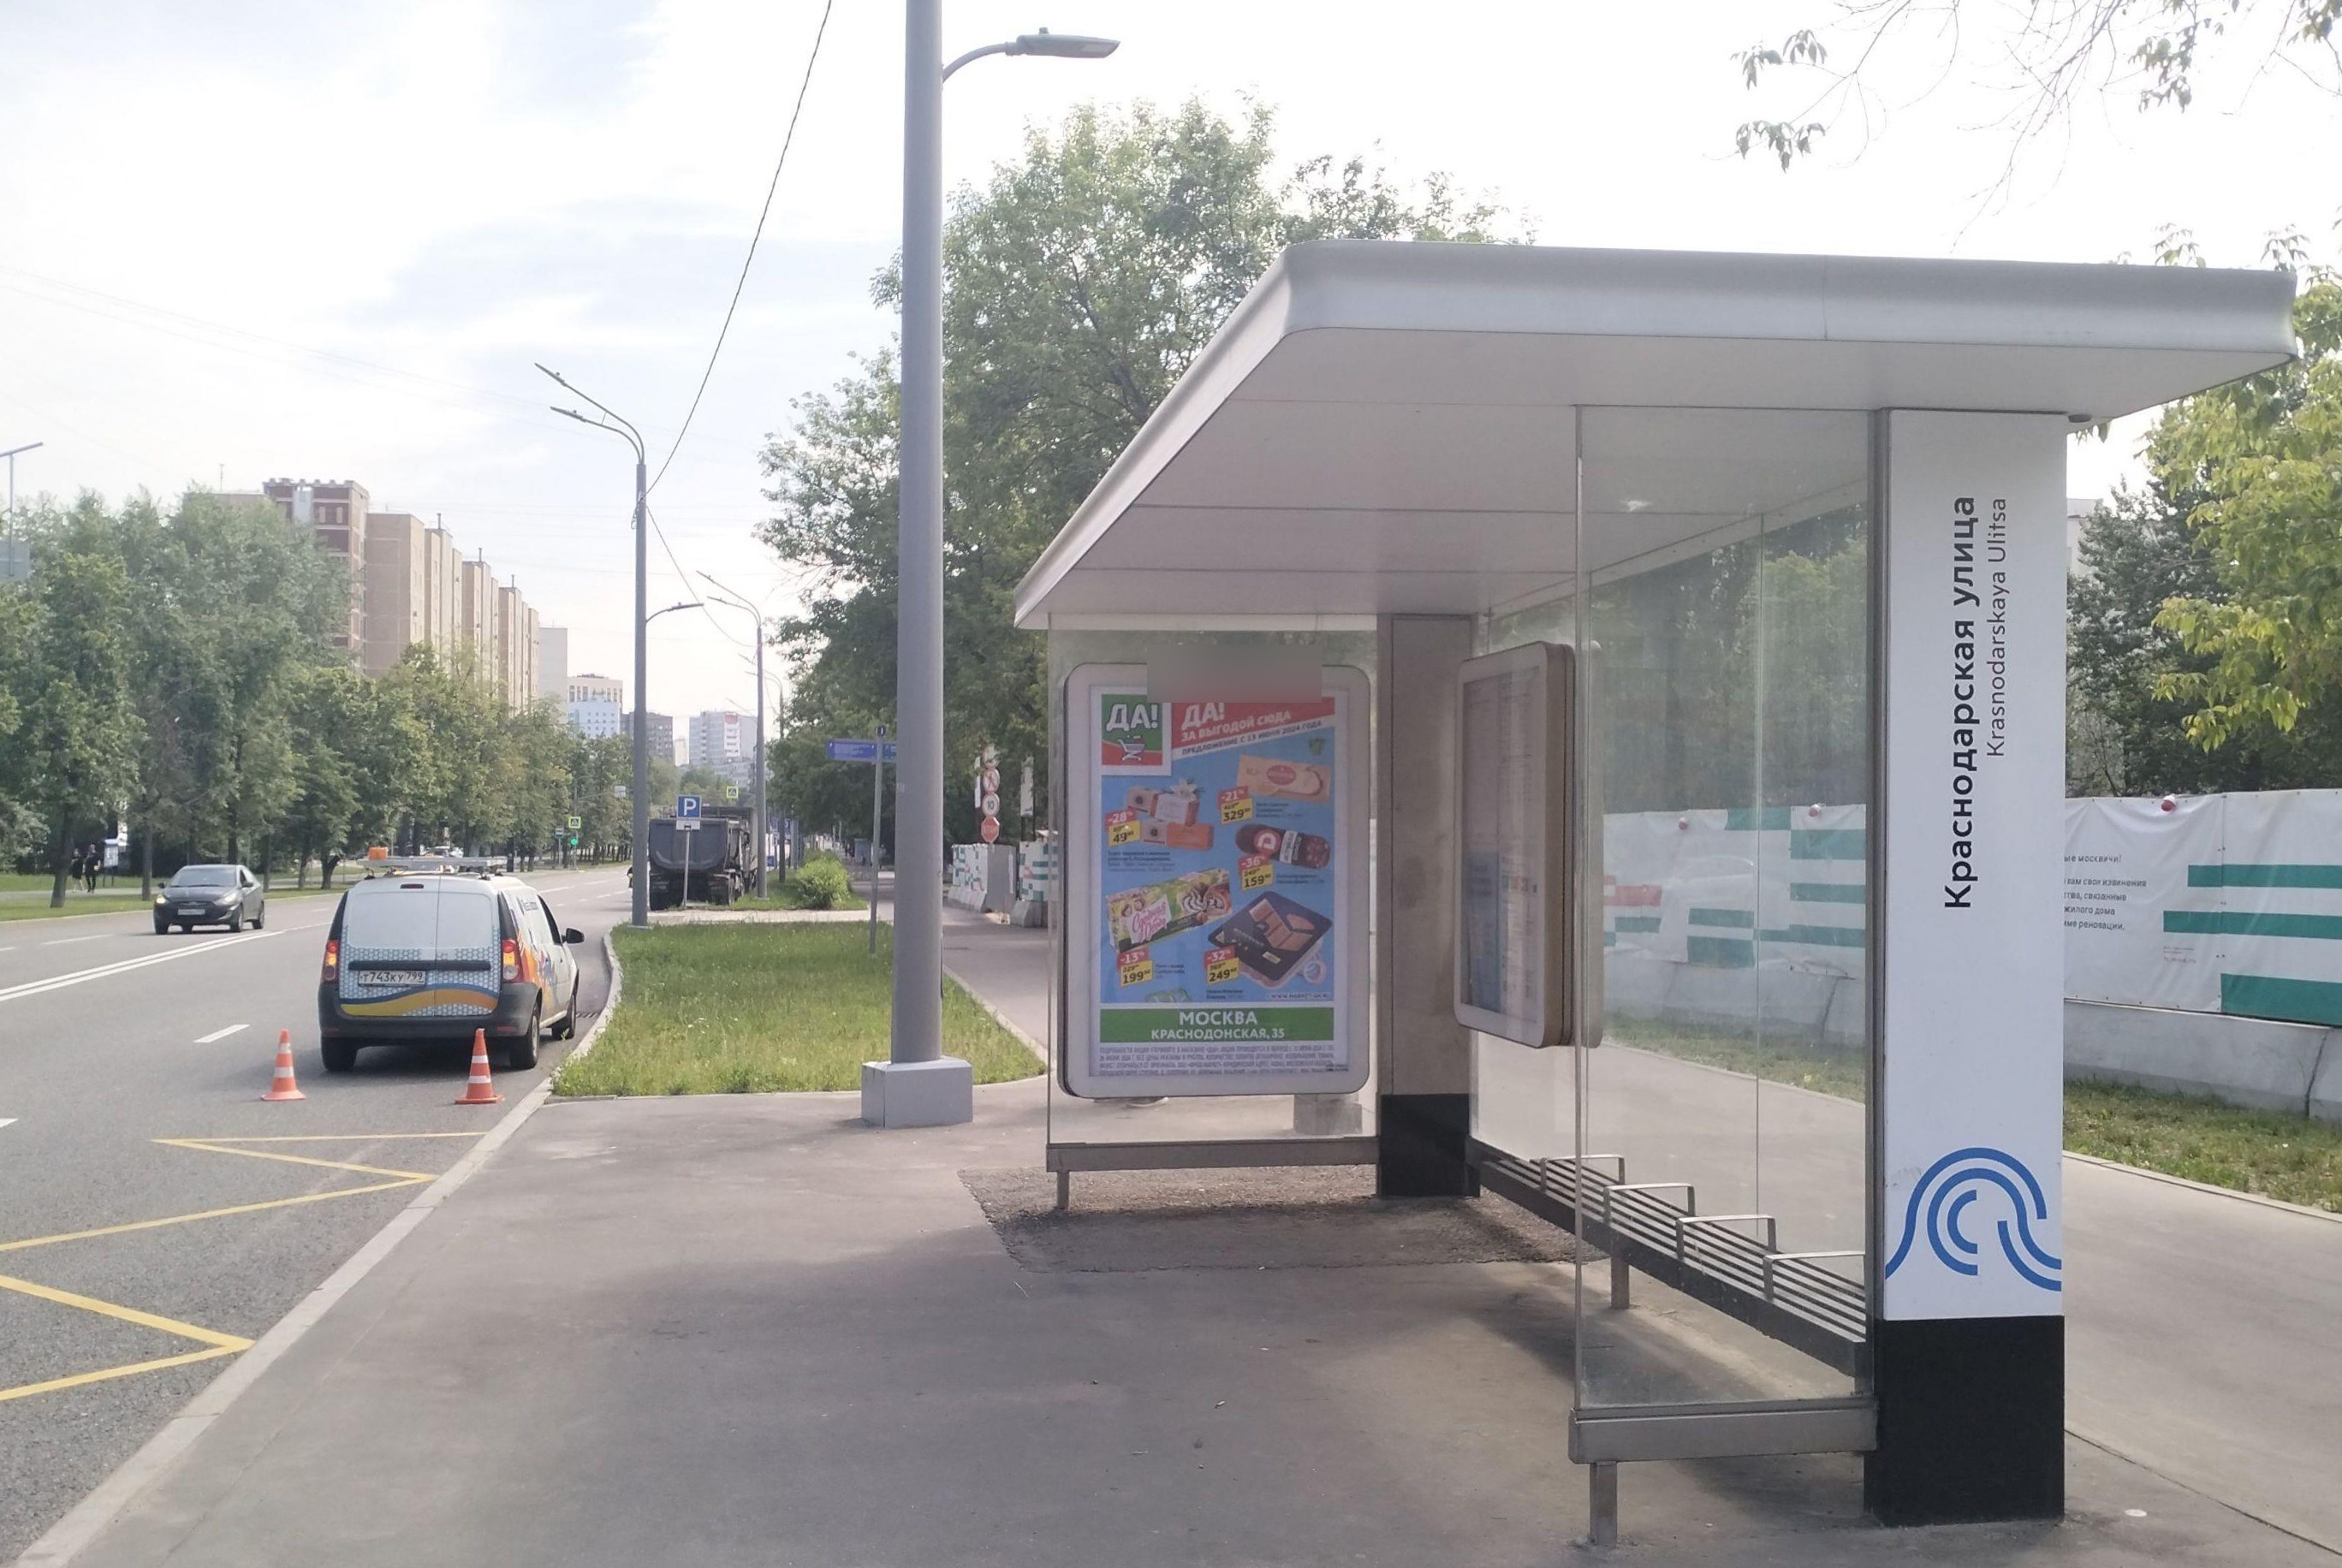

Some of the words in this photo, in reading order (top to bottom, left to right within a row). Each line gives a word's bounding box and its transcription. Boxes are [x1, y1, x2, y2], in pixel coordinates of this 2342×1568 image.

[1988, 498, 2006, 562] Ulitsa
[1953, 496, 1979, 607] улица
[1987, 571, 2010, 757] Krasnodarskaya
[1106, 704, 1158, 732] ДА!
[1181, 703, 1225, 730] ДА!
[1181, 732, 1196, 742] ЗА
[1199, 716, 1254, 738] ВЫГОДОЙ
[1257, 710, 1291, 726] СЮДА
[1945, 621, 1979, 908] Краснодарская
[684, 799, 696, 816] P
[1245, 876, 1264, 888] 159
[1123, 971, 1143, 984] 199
[1210, 970, 1230, 983] 249
[1180, 1011, 1258, 1026] МОСКВА
[1151, 1028, 1270, 1040] КРАСНОДОНСКАЯ,
[1271, 1028, 1285, 1039] 35
